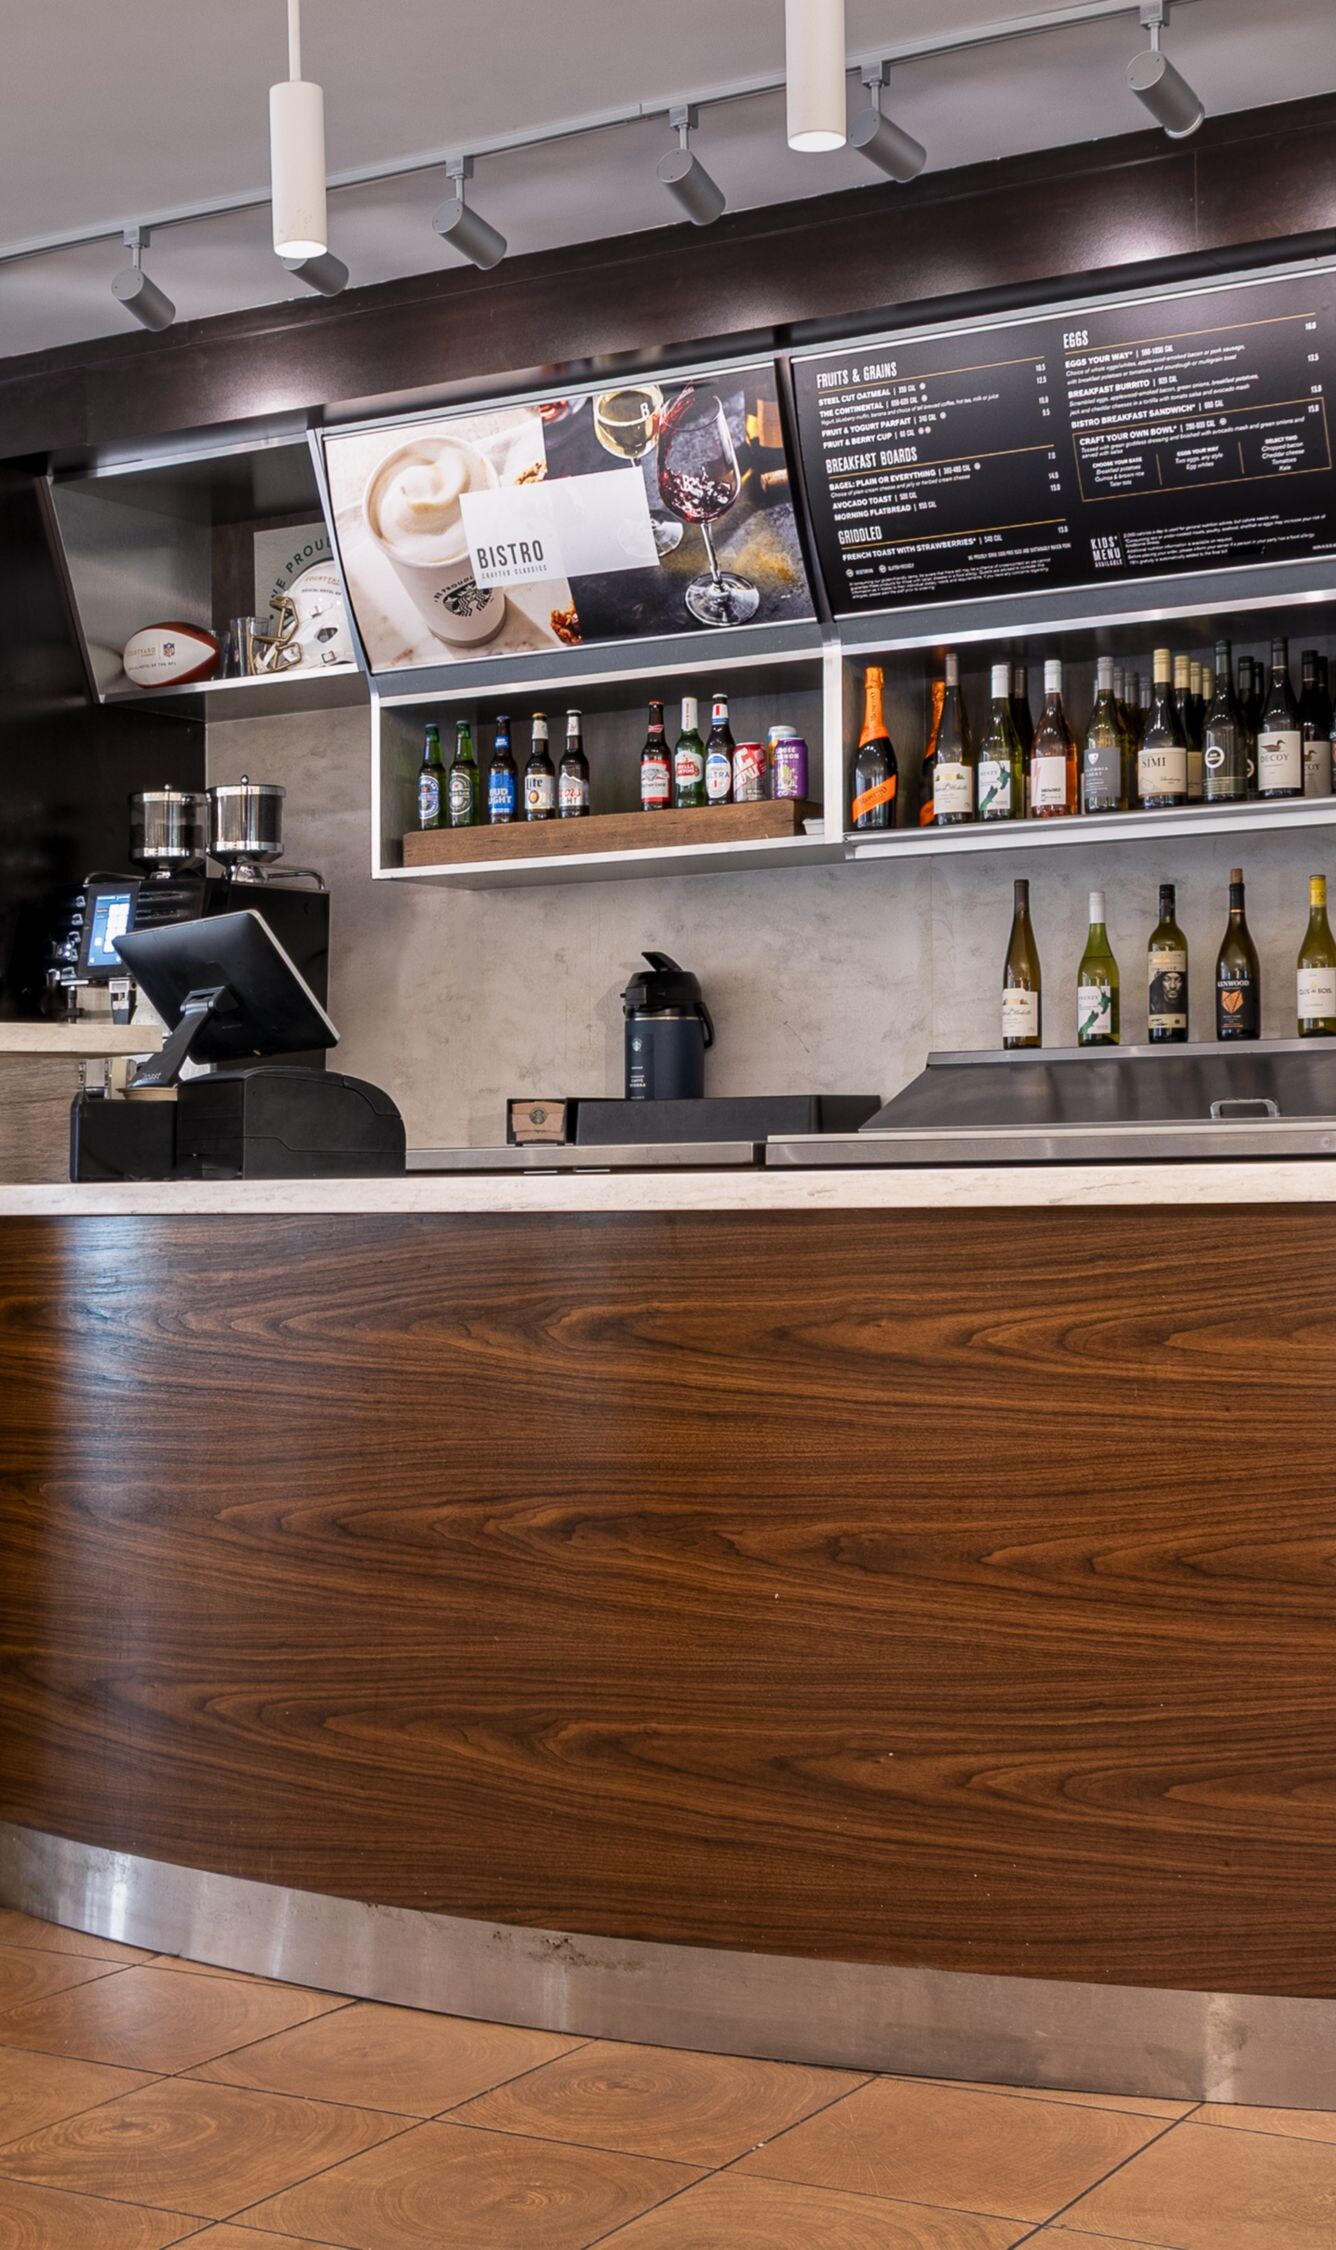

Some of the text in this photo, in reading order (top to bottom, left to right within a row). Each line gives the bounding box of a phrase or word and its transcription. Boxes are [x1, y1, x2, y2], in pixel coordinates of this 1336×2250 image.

[1063, 330, 1088, 348] EGGS
[1065, 358, 1087, 368] EGGS
[1088, 354, 1110, 364] YOUR
[816, 362, 897, 388] FRUITS & GRAINS
[819, 396, 840, 406] STEEL
[841, 394, 855, 402] CUT
[857, 389, 890, 400] OATMEAL
[1068, 385, 1114, 398] BREAKFAST
[1115, 380, 1150, 391] BURRITO
[819, 409, 834, 418] THE
[835, 402, 883, 415] CONTINENTAL
[822, 428, 842, 437] FRUIT
[849, 422, 879, 433] YOGURT
[880, 417, 911, 428] PARFAIT
[1071, 418, 1100, 429] BISTRO
[1102, 412, 1148, 424] BREAKFAST
[823, 439, 843, 449] FRUIT
[851, 435, 876, 445] BERRY
[877, 432, 893, 441] CUP
[1080, 436, 1105, 446] CRAFT
[1106, 433, 1128, 442] YOUR
[1130, 430, 1149, 439] OWN
[826, 447, 918, 473] BREAKFAST BOARDS
[829, 481, 855, 491] BAGEL:
[856, 478, 876, 487] PLAIN
[890, 469, 936, 482] EVERYTHING
[832, 499, 868, 510] AVOCADO
[869, 495, 892, 505] TOAST
[834, 510, 869, 521] MORNING
[870, 504, 911, 516] FLATBREAD
[838, 526, 882, 545] GRIDDLED
[1091, 536, 1118, 550] KIDS'
[477, 540, 544, 569] BISTRO
[842, 552, 872, 561] FRENCH
[873, 548, 896, 557] TOAST
[896, 546, 915, 554] WITH
[1093, 547, 1121, 561] MENU
[482, 564, 548, 580] CRAFTED CLASSICS
[1095, 559, 1122, 568] AVAILABLE
[1142, 757, 1166, 768] SIMI
[1261, 753, 1289, 763] DECOY
